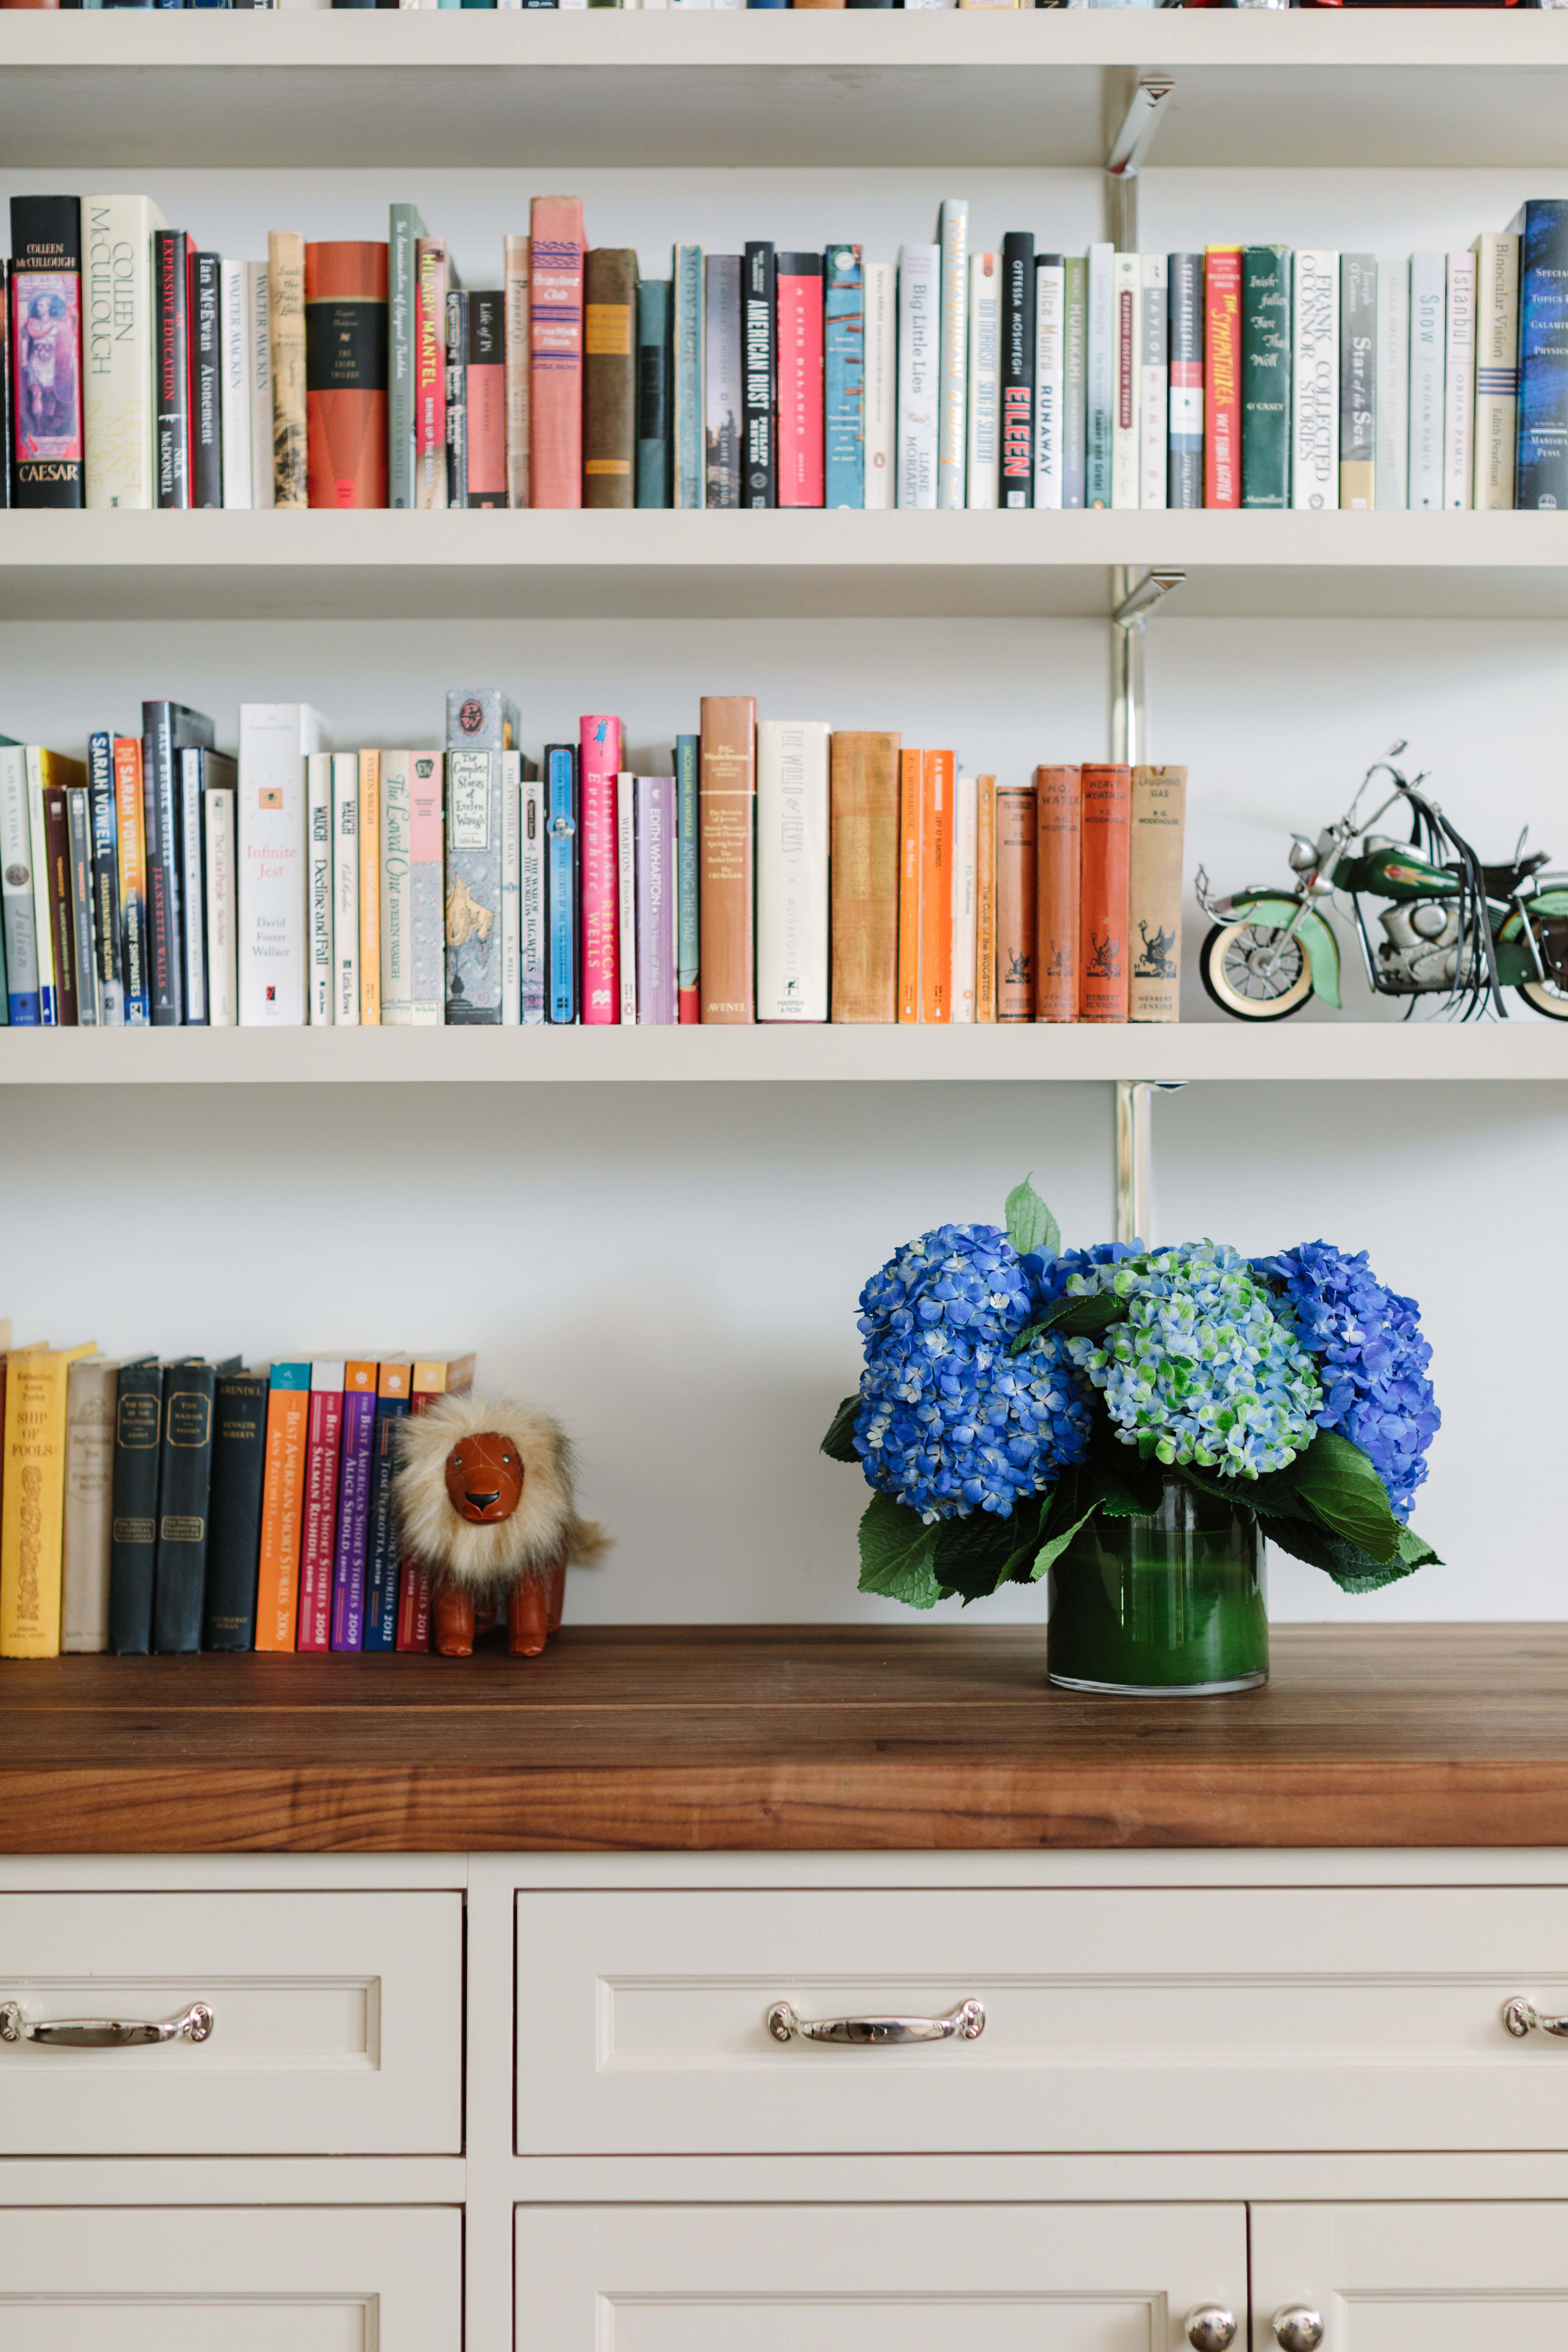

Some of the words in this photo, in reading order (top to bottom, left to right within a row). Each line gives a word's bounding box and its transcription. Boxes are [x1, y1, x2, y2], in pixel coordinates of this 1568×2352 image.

[27, 244, 64, 253] COLLEEN
[947, 215, 966, 264] TONI
[91, 207, 111, 375] McCULLOUGH
[163, 239, 173, 313] EXPENSIVE
[200, 259, 213, 283] Ian
[422, 254, 436, 314] HILARY
[1012, 260, 1023, 307] OTTESSA
[1494, 244, 1508, 310] Binocular
[113, 242, 134, 342] COLLEEN
[229, 274, 241, 325] WALTER
[256, 274, 267, 327] WALTER
[796, 288, 803, 296] A
[910, 285, 926, 310] Big
[979, 299, 997, 318] TONI
[1042, 280, 1058, 315] Alice
[1301, 255, 1316, 359] O'CONNOR
[1316, 274, 1332, 342] FRANK
[1453, 270, 1472, 346] Istanbul
[176, 312, 183, 327] AN
[200, 288, 213, 351] McEwan
[747, 300, 768, 369] AMERICAN
[796, 307, 804, 347] FINE
[913, 315, 926, 356] Little
[947, 270, 964, 377] MORRISON
[1150, 291, 1159, 363] NAYLOR
[1420, 295, 1440, 344] Snow
[1493, 315, 1508, 358] Vision
[163, 319, 174, 400] EDUCATION
[231, 330, 240, 389] MACKEN
[257, 332, 267, 389] MACKEN
[422, 320, 436, 388] MANTEL
[978, 320, 995, 371] MORRISON
[1012, 312, 1022, 374] MOSHFEGH
[1041, 324, 1058, 370] Munro
[1070, 304, 1081, 383] MURAKAMI
[1210, 308, 1233, 406] SYMPATHIZER
[1353, 337, 1371, 376] Star
[748, 374, 769, 409] RUST
[796, 358, 804, 435] BALANCE
[913, 362, 926, 393] Lies
[949, 390, 962, 404] a
[977, 381, 995, 404] SONG
[1122, 374, 1129, 385] IN
[1351, 380, 1366, 391] of
[201, 364, 215, 444] Atonement
[978, 408, 995, 418] OF
[1299, 380, 1315, 461] STORIES
[1353, 393, 1367, 409] the
[750, 419, 758, 463] MEYER
[758, 416, 768, 467] PHILIPP
[942, 406, 962, 468] mercy
[1004, 387, 1030, 477] EILEEN
[1040, 385, 1052, 475] RUNAWAY
[1315, 361, 1331, 482] COLLECTED
[1353, 411, 1371, 445] Sea
[1492, 408, 1502, 435] Edith
[977, 421, 995, 463] SOLOMON
[1491, 438, 1502, 486] Pearlman
[19, 465, 77, 483] CAESAR
[162, 431, 172, 496] McDONELL
[172, 448, 182, 477] NICK
[907, 436, 917, 506] MORIARTY
[920, 452, 929, 491] LIANE
[92, 737, 108, 789] SARAH
[366, 758, 375, 789] EVELYN
[462, 755, 477, 763] The
[683, 745, 693, 795] JACQUELINE
[120, 765, 135, 816] SARAH
[385, 774, 406, 800] The
[1042, 796, 1079, 805] WATER
[1048, 784, 1072, 793] HOT
[1151, 790, 1169, 798] GAS
[94, 794, 110, 859] VOWELL
[314, 806, 327, 842] WAUGH
[341, 800, 355, 834] WAUGH
[385, 804, 409, 854] Loved
[587, 772, 600, 891] Everywhere
[650, 809, 661, 840] EDITH
[684, 796, 693, 837] WINSPEAR
[123, 819, 137, 880] VOWELL
[247, 845, 296, 858] Infinite
[622, 817, 631, 872] WHARTON
[257, 864, 283, 881] Jest
[314, 859, 328, 909] Decline
[388, 858, 408, 894] One
[650, 844, 661, 905] WHARTON
[682, 843, 694, 890] AMONG
[101, 873, 111, 938] ASSASSINATION
[126, 887, 138, 904] THE
[152, 867, 165, 942] JEANNETTE
[683, 894, 694, 914] THE
[982, 904, 990, 923] Code
[128, 906, 139, 942] WORDY
[256, 918, 286, 928] David
[256, 932, 286, 942] Foster
[315, 912, 328, 936] and
[390, 898, 399, 936] EVELYN
[684, 918, 694, 943] MAD
[983, 925, 990, 935] of
[15, 909, 31, 968] Julian
[252, 947, 290, 957] Wallace
[315, 939, 329, 965] Fall
[588, 912, 599, 968] WELLS
[602, 900, 612, 981] REBECCA
[103, 940, 113, 979] VACATION
[129, 944, 141, 997] SHIPMATES
[157, 948, 166, 988] WALLS
[391, 939, 400, 979] WAUGH
[342, 972, 351, 994] Little,
[342, 996, 351, 1015] Brown
[708, 1003, 746, 1011] AVENEL
[17, 1413, 47, 1425] SHIP
[22, 1428, 39, 1439] OF
[285, 1411, 300, 1440] BEST
[324, 1415, 337, 1443] BEST
[359, 1415, 371, 1444] BEST
[12, 1445, 52, 1456] FOOLS
[281, 1444, 298, 1508] AMERICAN
[320, 1447, 336, 1511] AMERICAN
[344, 1458, 356, 1496] ALICE
[355, 1448, 369, 1512] AMERICAN
[279, 1512, 294, 1552] SHORT
[319, 1514, 332, 1554] SHORT
[340, 1501, 354, 1553] SEBOLD,
[352, 1515, 366, 1554] SHORT
[277, 1556, 292, 1604] STORIES
[316, 1558, 330, 1607] STORIES
[350, 1558, 362, 1607] STORIES
[384, 1561, 396, 1610] STORIES
[276, 1610, 290, 1640] 2006
[315, 1613, 326, 1644] 2008
[347, 1613, 359, 1644] 2009
[382, 1614, 393, 1641] 2012
[415, 1613, 426, 1640] 2013
